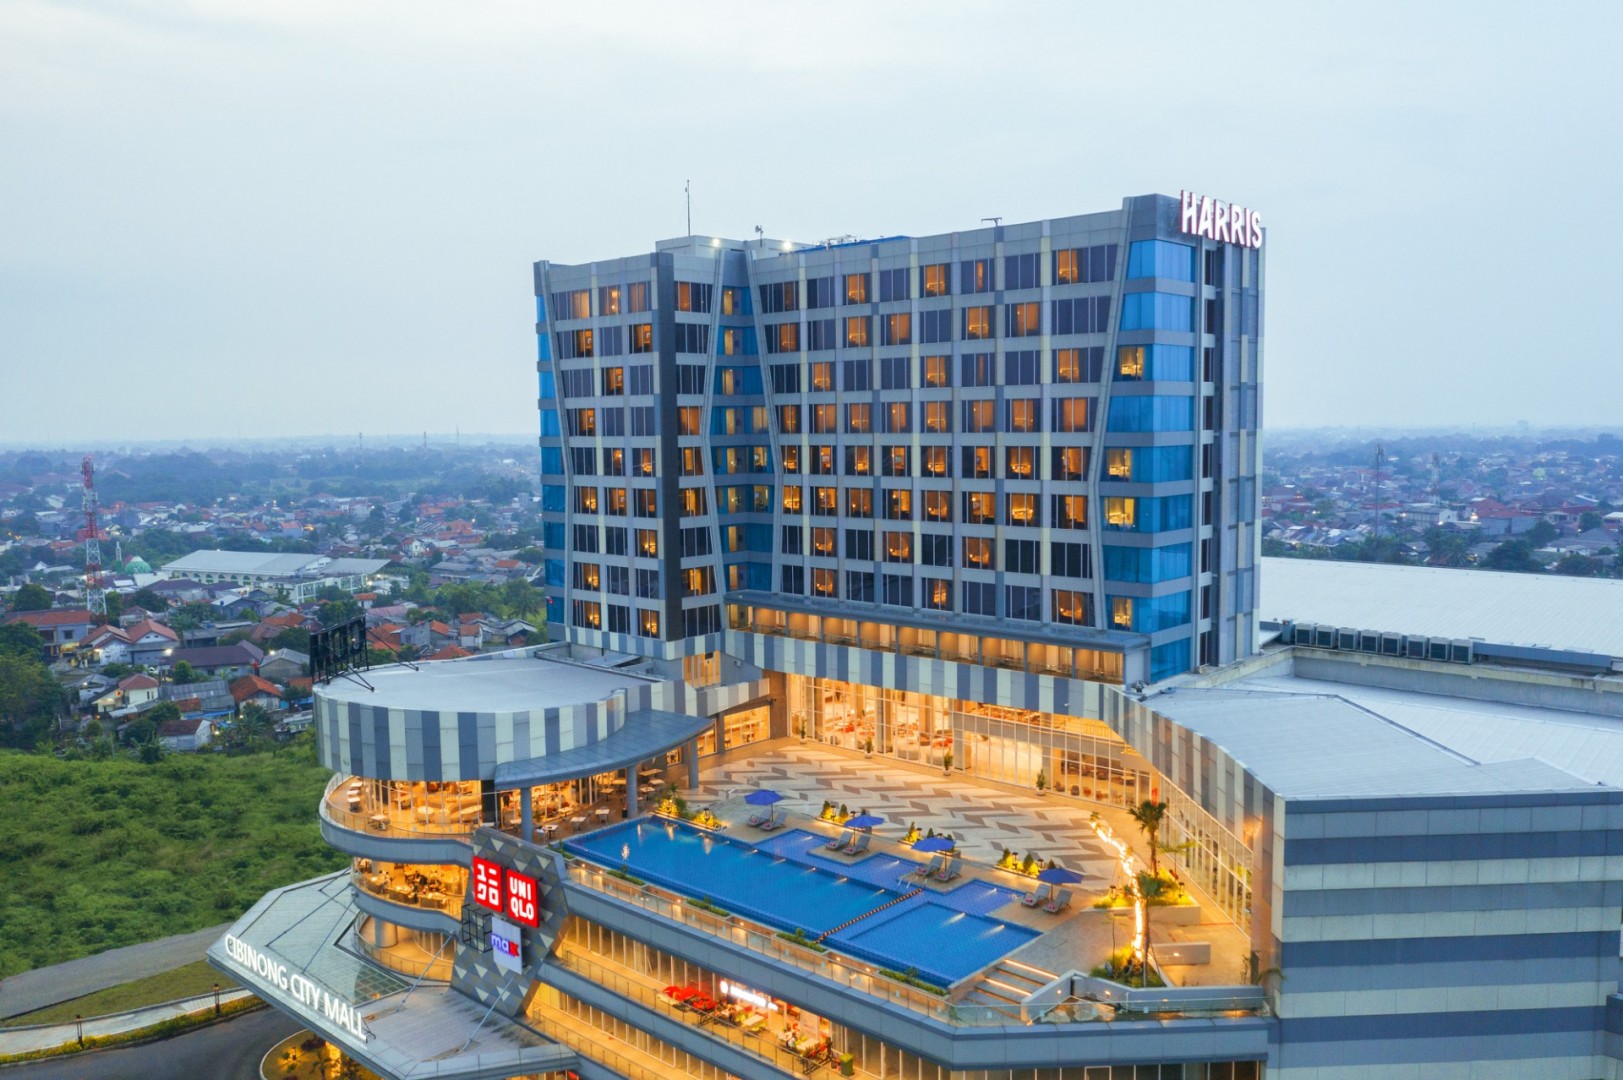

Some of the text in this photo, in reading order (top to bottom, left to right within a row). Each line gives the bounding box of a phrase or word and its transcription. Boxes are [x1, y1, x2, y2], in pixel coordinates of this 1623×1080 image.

[1181, 190, 1262, 248] HARRIS
[510, 876, 532, 901] UNI
[510, 898, 534, 920] QLO
[225, 934, 368, 1043] CIBINONG CITY MALL
